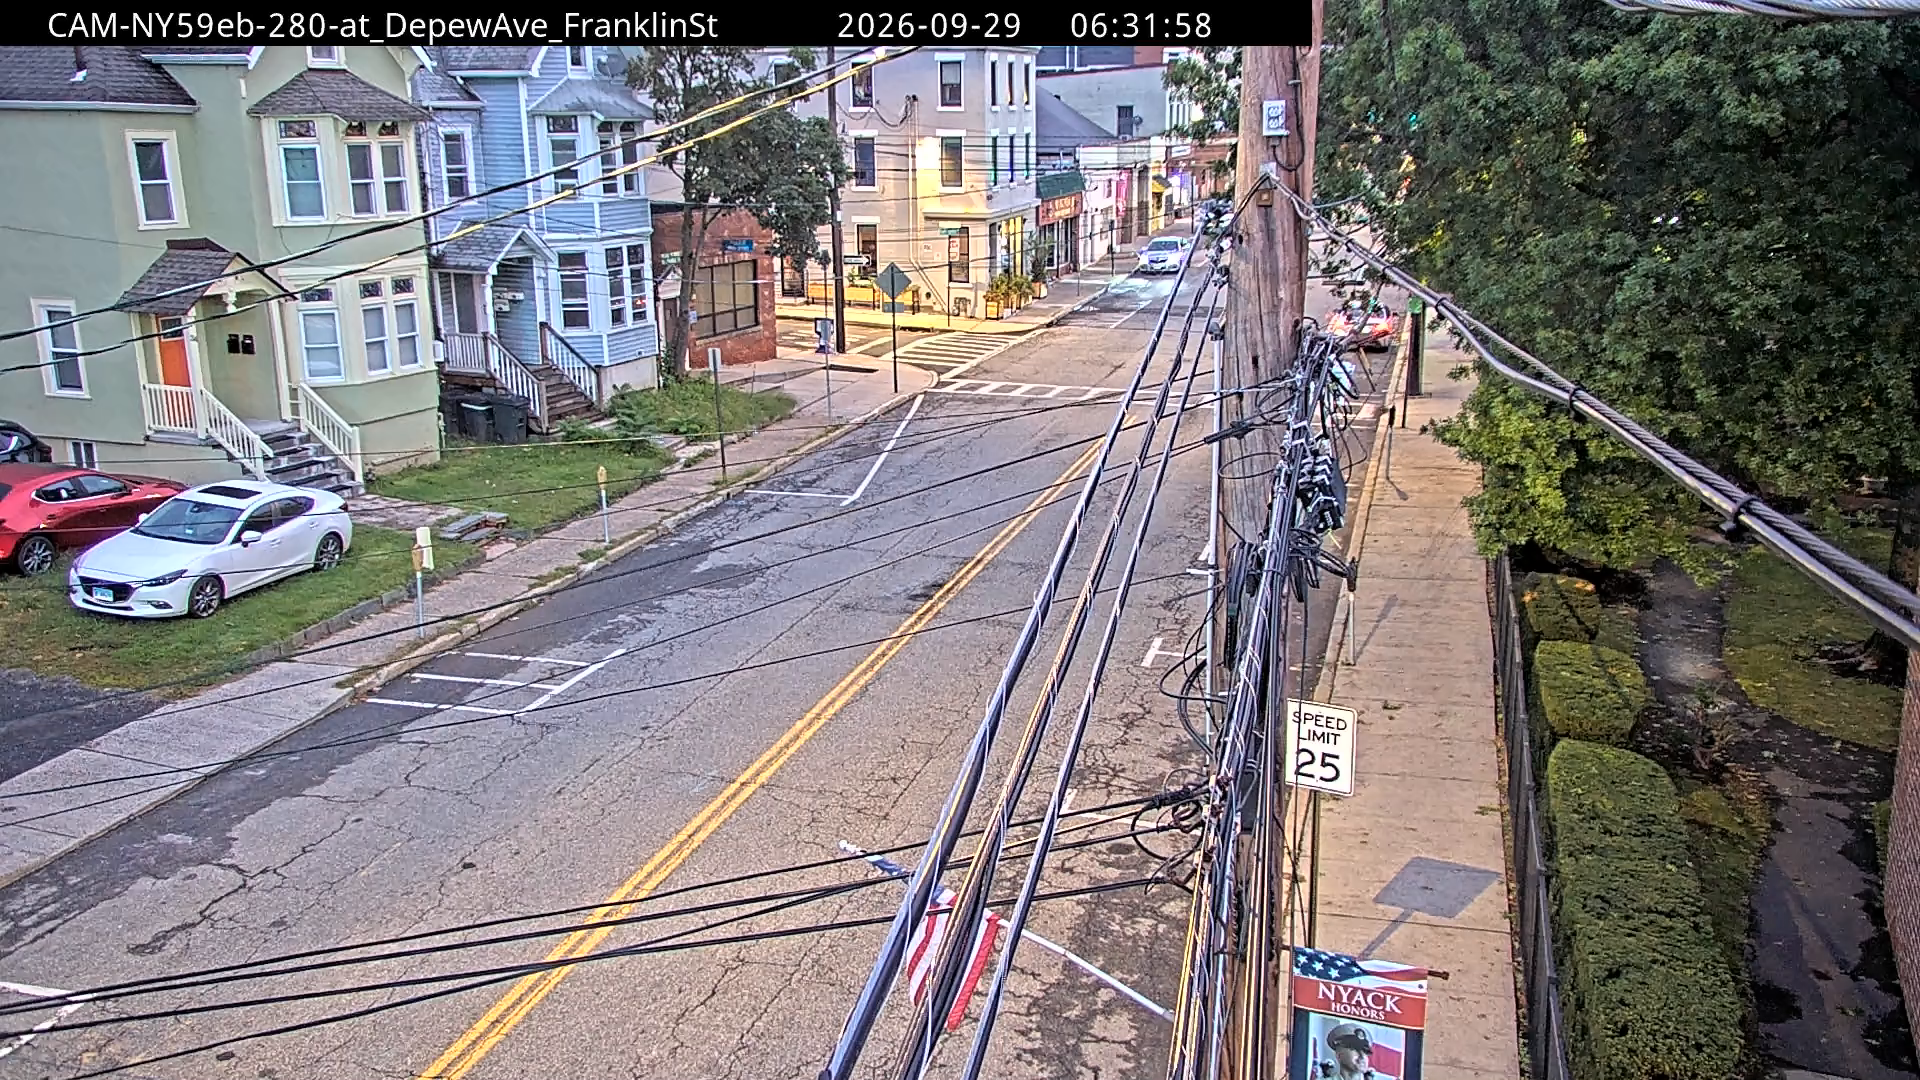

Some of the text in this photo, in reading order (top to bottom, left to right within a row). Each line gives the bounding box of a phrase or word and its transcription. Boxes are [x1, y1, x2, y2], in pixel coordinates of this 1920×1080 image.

[1292, 711, 1347, 731] SPEED
[1298, 728, 1341, 746] LIMIT
[1294, 748, 1340, 782] 25
[1317, 981, 1403, 1014] NYACK
[1331, 1002, 1386, 1021] HONORS
